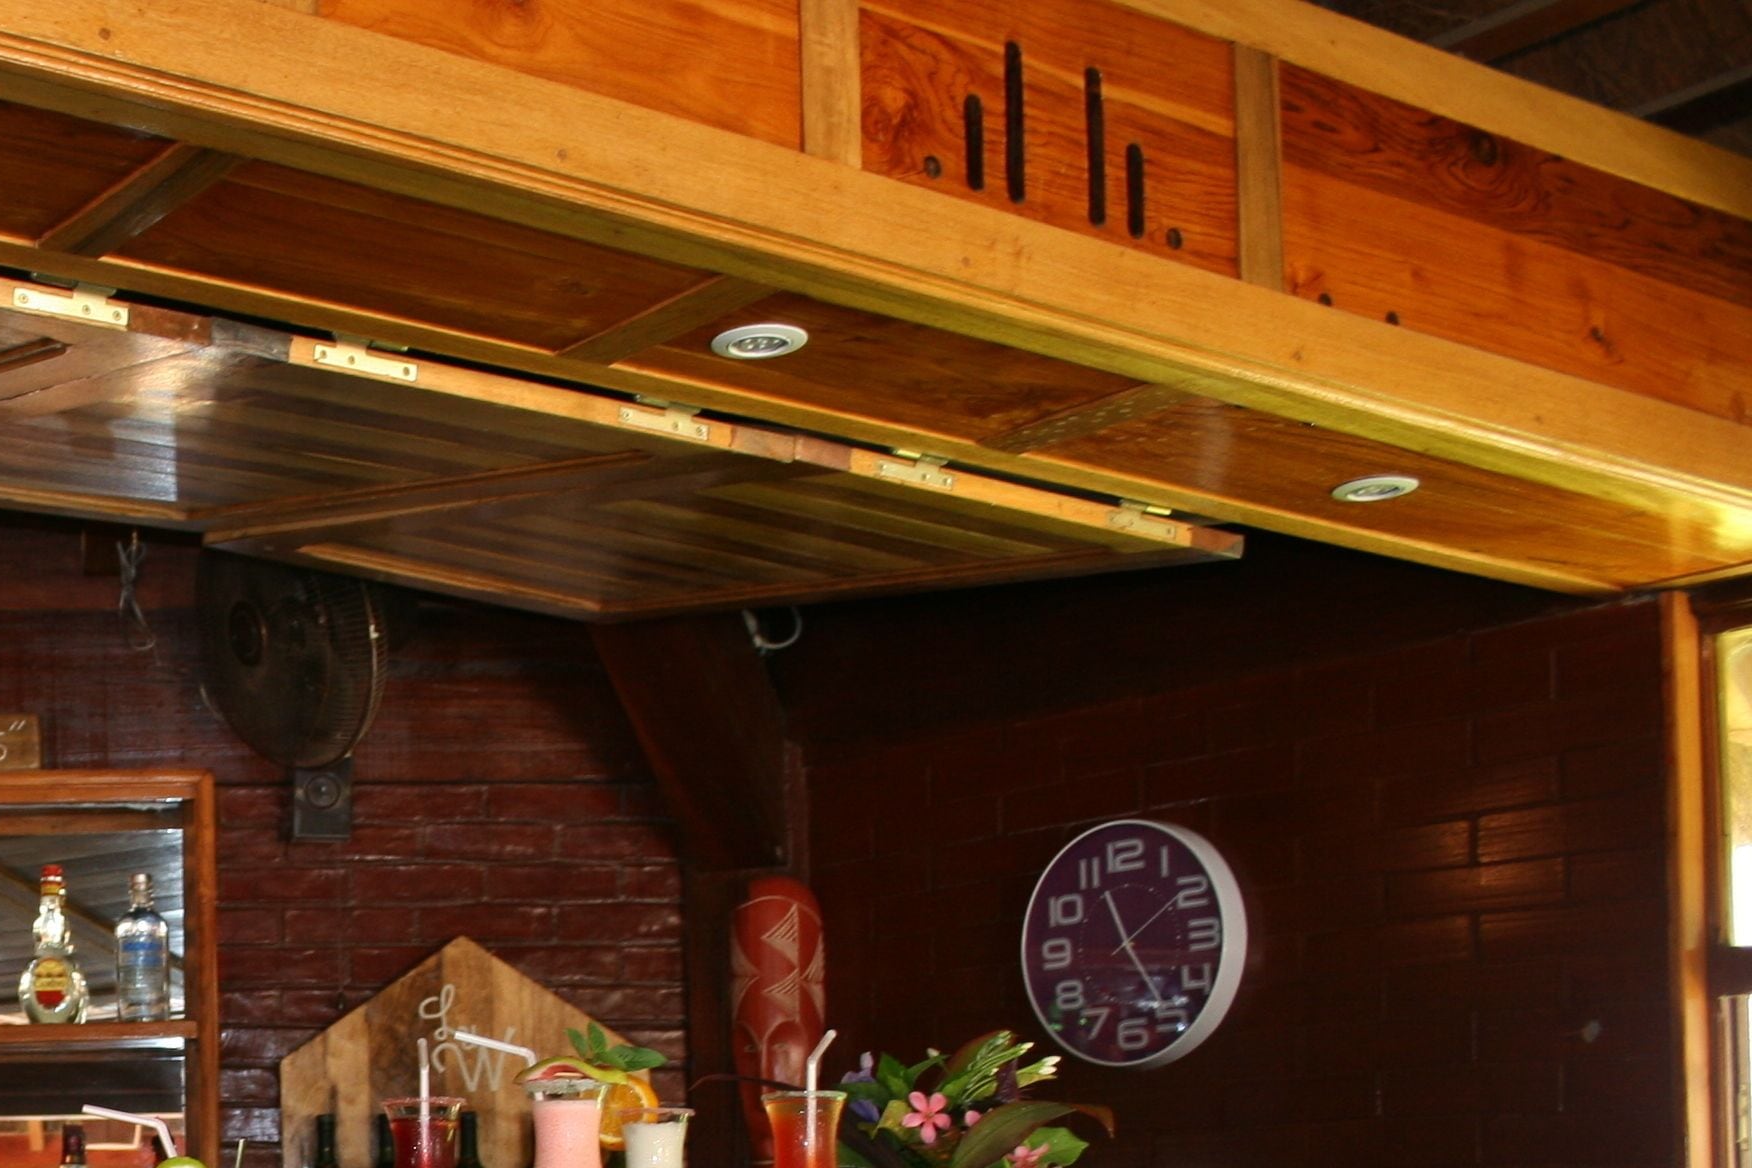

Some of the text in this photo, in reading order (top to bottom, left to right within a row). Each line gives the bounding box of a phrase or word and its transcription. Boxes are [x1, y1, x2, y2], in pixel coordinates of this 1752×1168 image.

[1079, 856, 1101, 890] 11
[1106, 838, 1145, 875] 12
[1160, 844, 1170, 878] 1
[1176, 874, 1209, 910] 2
[1048, 893, 1084, 928] 10
[1188, 916, 1221, 952] 3
[1041, 937, 1072, 971] 9
[1055, 979, 1085, 1010] 8
[1181, 963, 1211, 995] 4
[1080, 1006, 1111, 1040] 7
[1117, 1017, 1150, 1051] 6
[1155, 1002, 1188, 1033] 5
